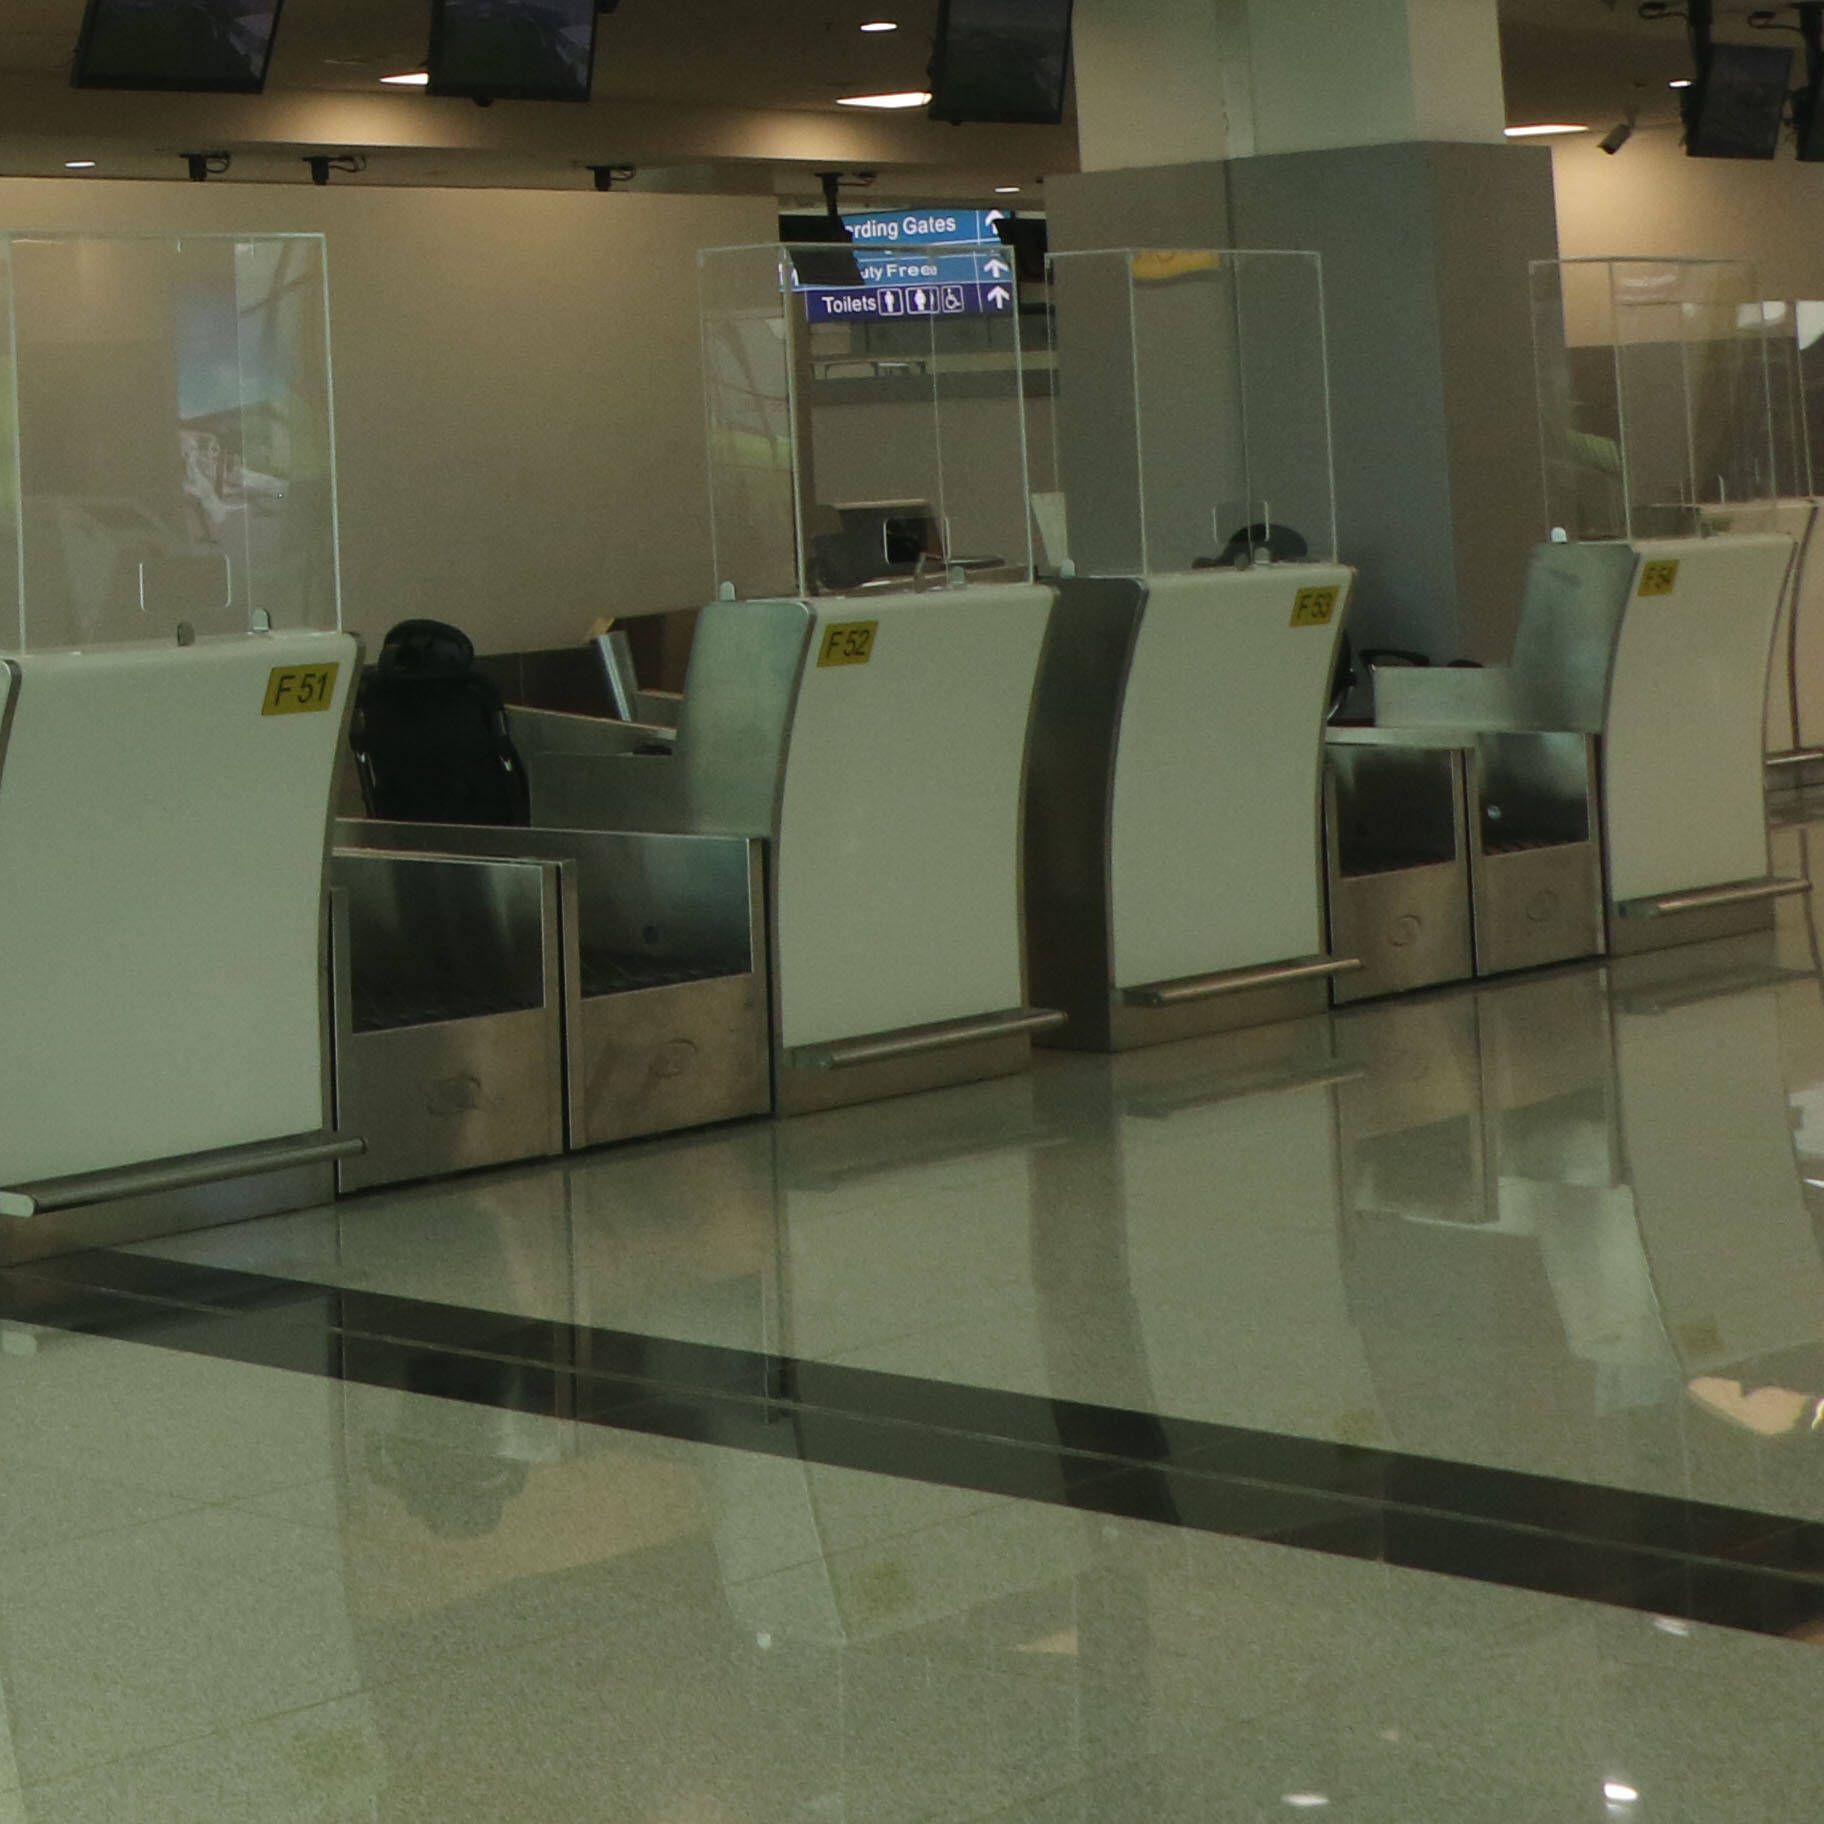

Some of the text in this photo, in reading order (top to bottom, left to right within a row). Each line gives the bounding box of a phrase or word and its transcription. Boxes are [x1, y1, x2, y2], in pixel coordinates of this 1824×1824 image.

[845, 216, 957, 239] rding Gates
[860, 263, 937, 281] uty Free
[821, 295, 877, 314] Toilets
